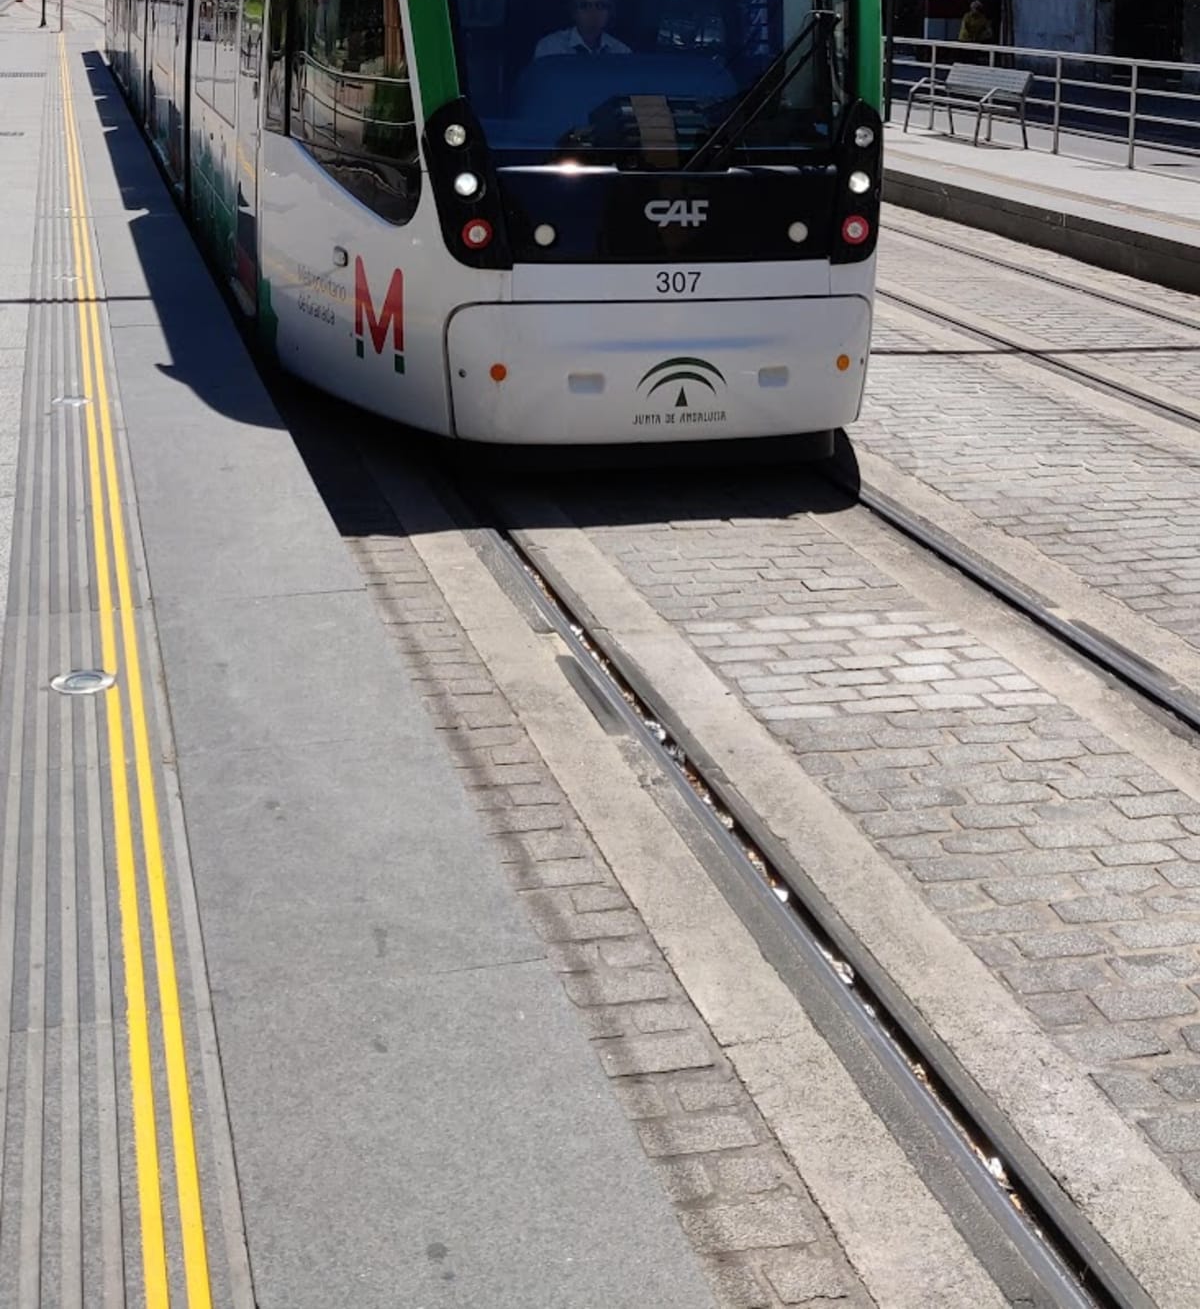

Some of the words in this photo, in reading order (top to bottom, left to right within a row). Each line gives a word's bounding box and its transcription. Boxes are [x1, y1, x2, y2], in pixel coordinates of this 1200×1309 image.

[644, 199, 710, 228] CAF
[655, 271, 702, 294] 307
[355, 255, 405, 375] M
[632, 413, 661, 425] JUNTA
[665, 413, 675, 424] DE
